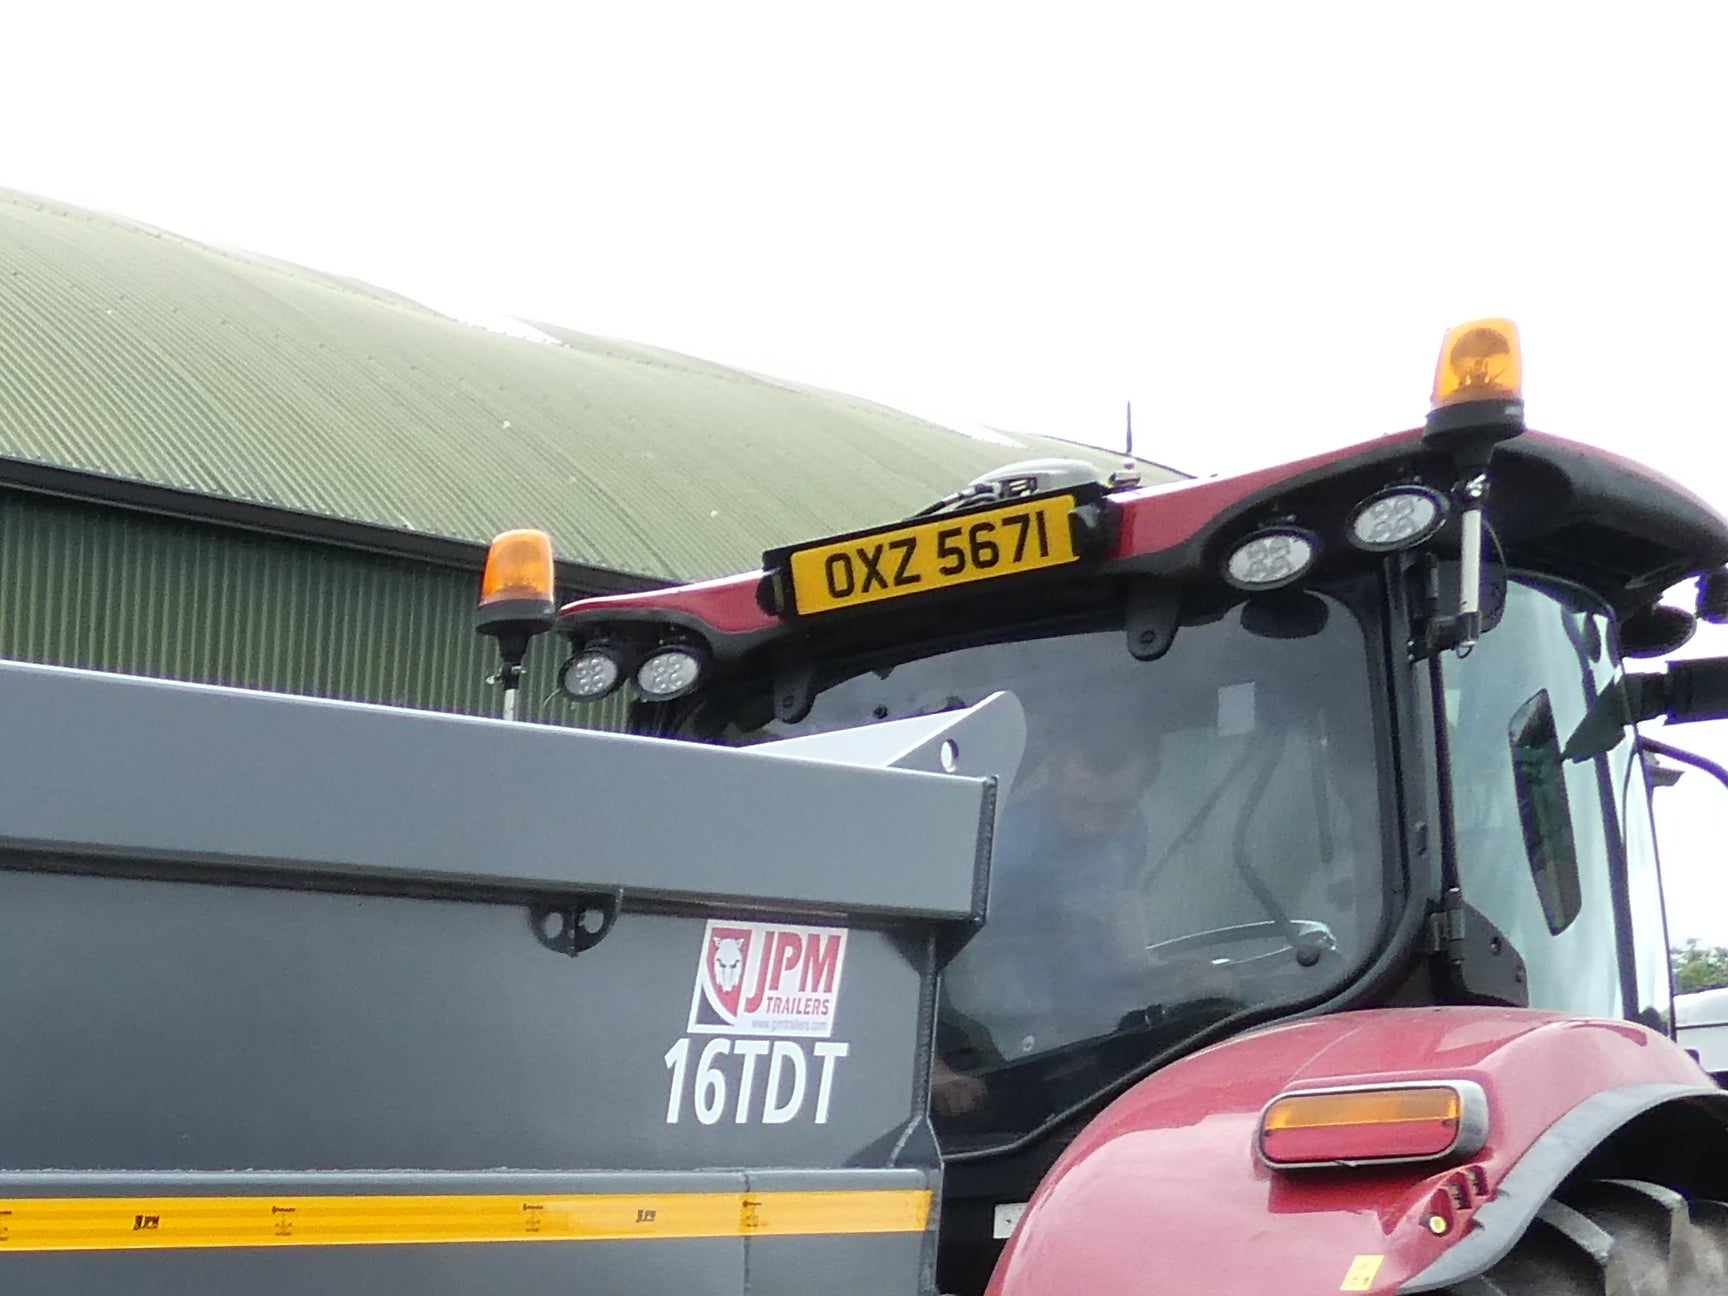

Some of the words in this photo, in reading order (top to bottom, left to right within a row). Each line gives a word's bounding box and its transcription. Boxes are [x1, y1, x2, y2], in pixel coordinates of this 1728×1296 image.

[825, 537, 921, 599] OXZ
[938, 510, 1049, 576] 5671
[744, 930, 842, 1013] JPM
[765, 996, 832, 1017] TRAILERS
[664, 1036, 849, 1125] 16TDT
